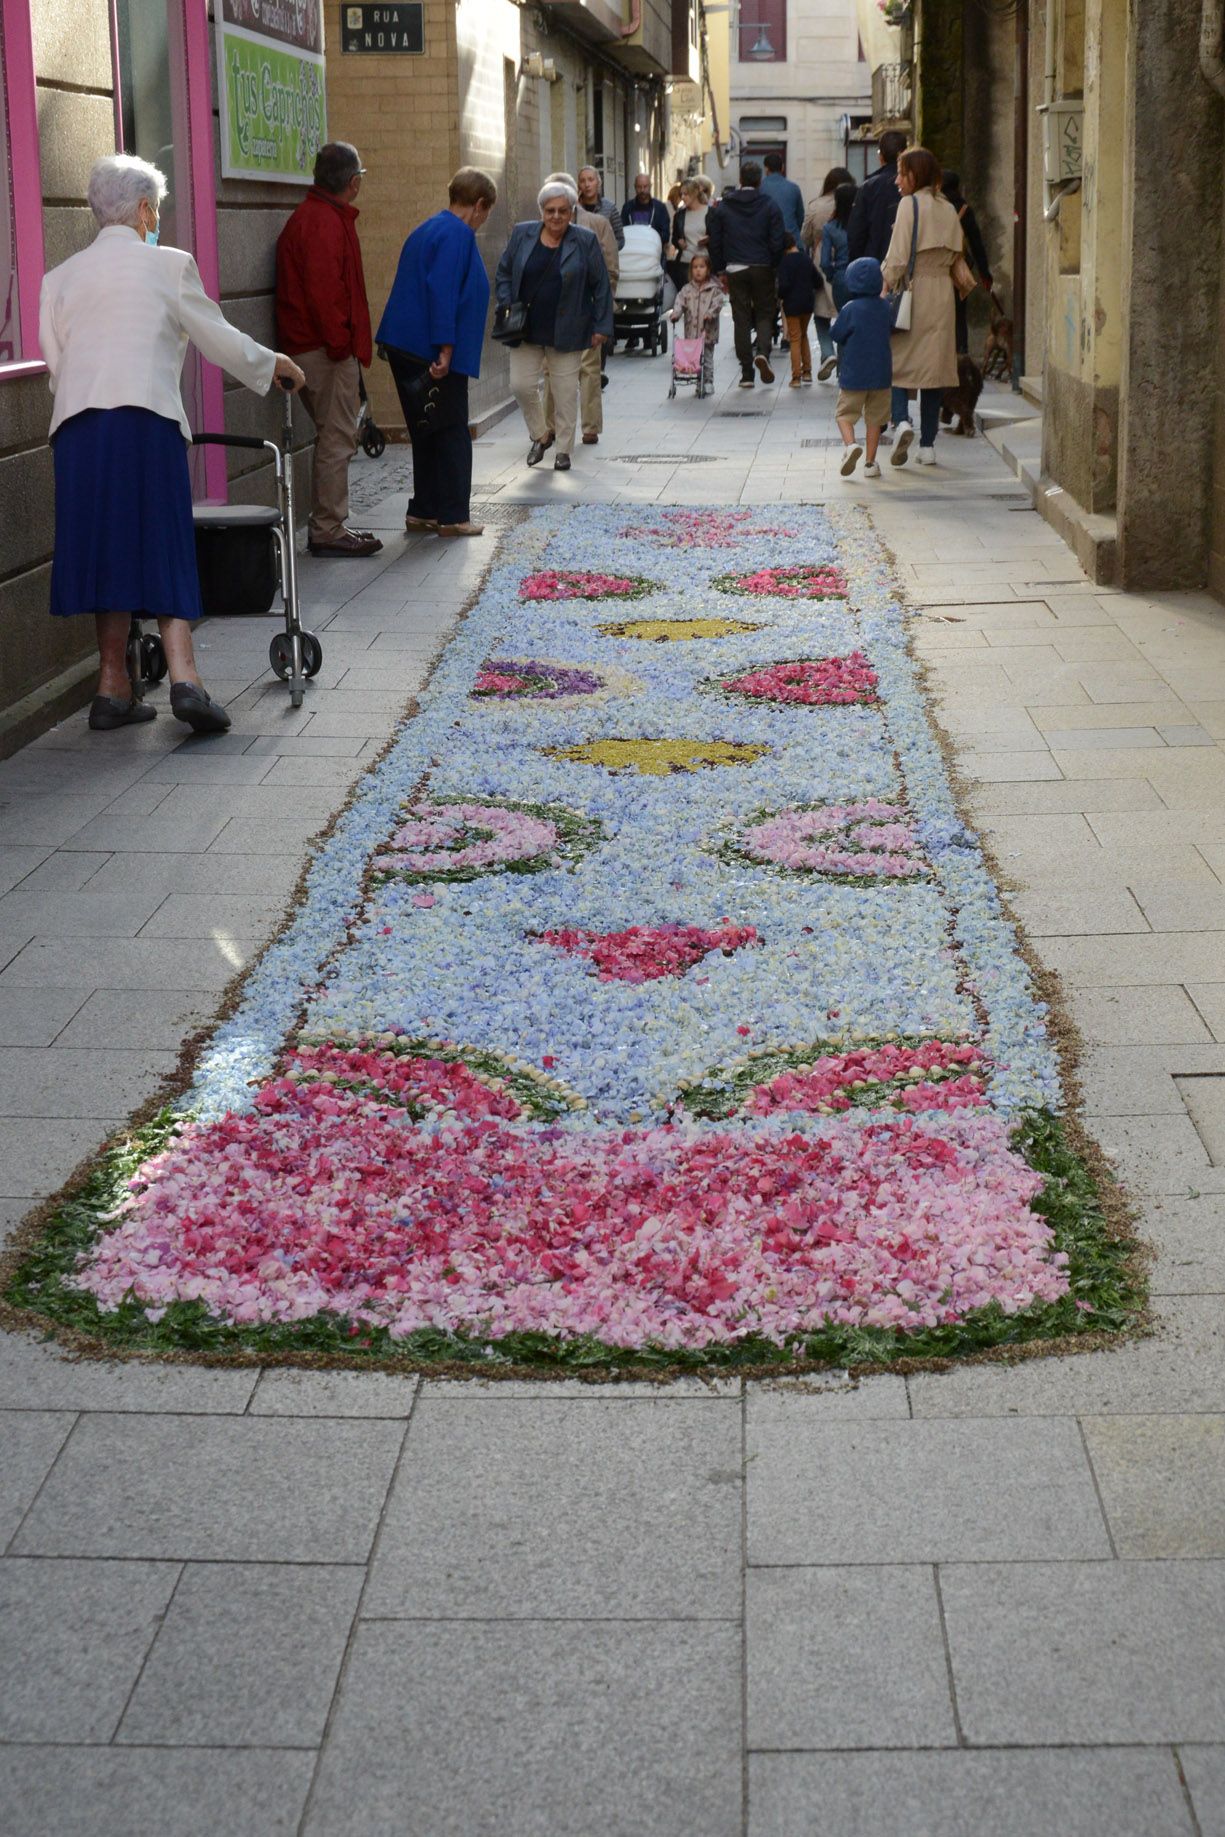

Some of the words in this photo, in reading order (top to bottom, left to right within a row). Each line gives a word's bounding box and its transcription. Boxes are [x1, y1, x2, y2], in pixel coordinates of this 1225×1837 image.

[374, 10, 399, 23] RUA
[365, 32, 408, 47] NOVA
[232, 49, 258, 155] tus
[261, 63, 321, 156] Caprichos
